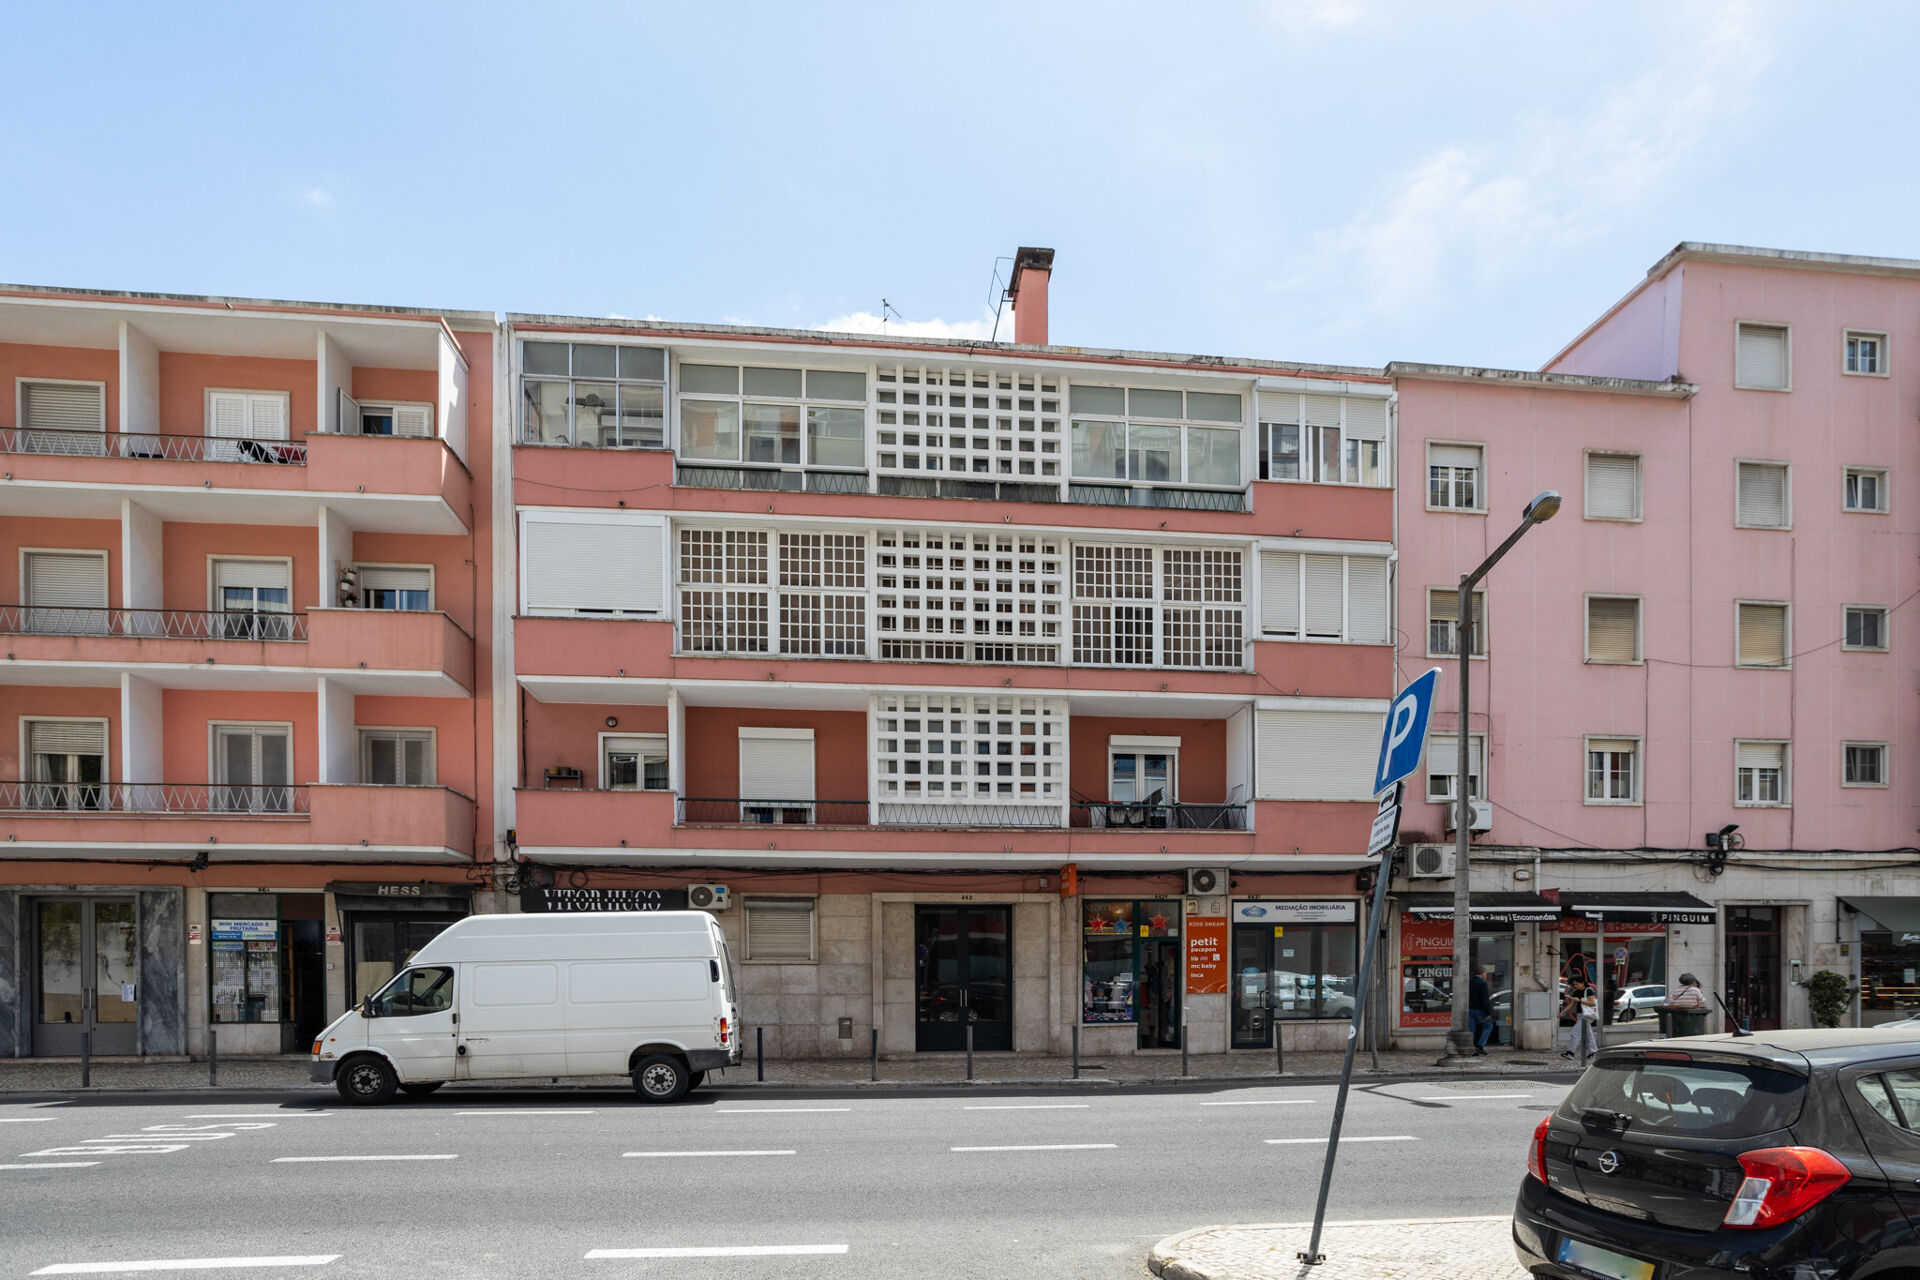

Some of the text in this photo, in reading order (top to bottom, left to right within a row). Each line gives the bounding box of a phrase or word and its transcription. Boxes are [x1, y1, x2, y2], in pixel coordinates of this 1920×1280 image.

[1381, 694, 1418, 783] P
[378, 885, 420, 896] HESS
[544, 889, 661, 911] VITOR HUGO
[1513, 913, 1557, 921] Encomendas
[1661, 913, 1710, 923] PINGUIM
[1190, 937, 1218, 948] petit
[1201, 962, 1217, 970] baby
[1417, 967, 1454, 978] PINGUI
